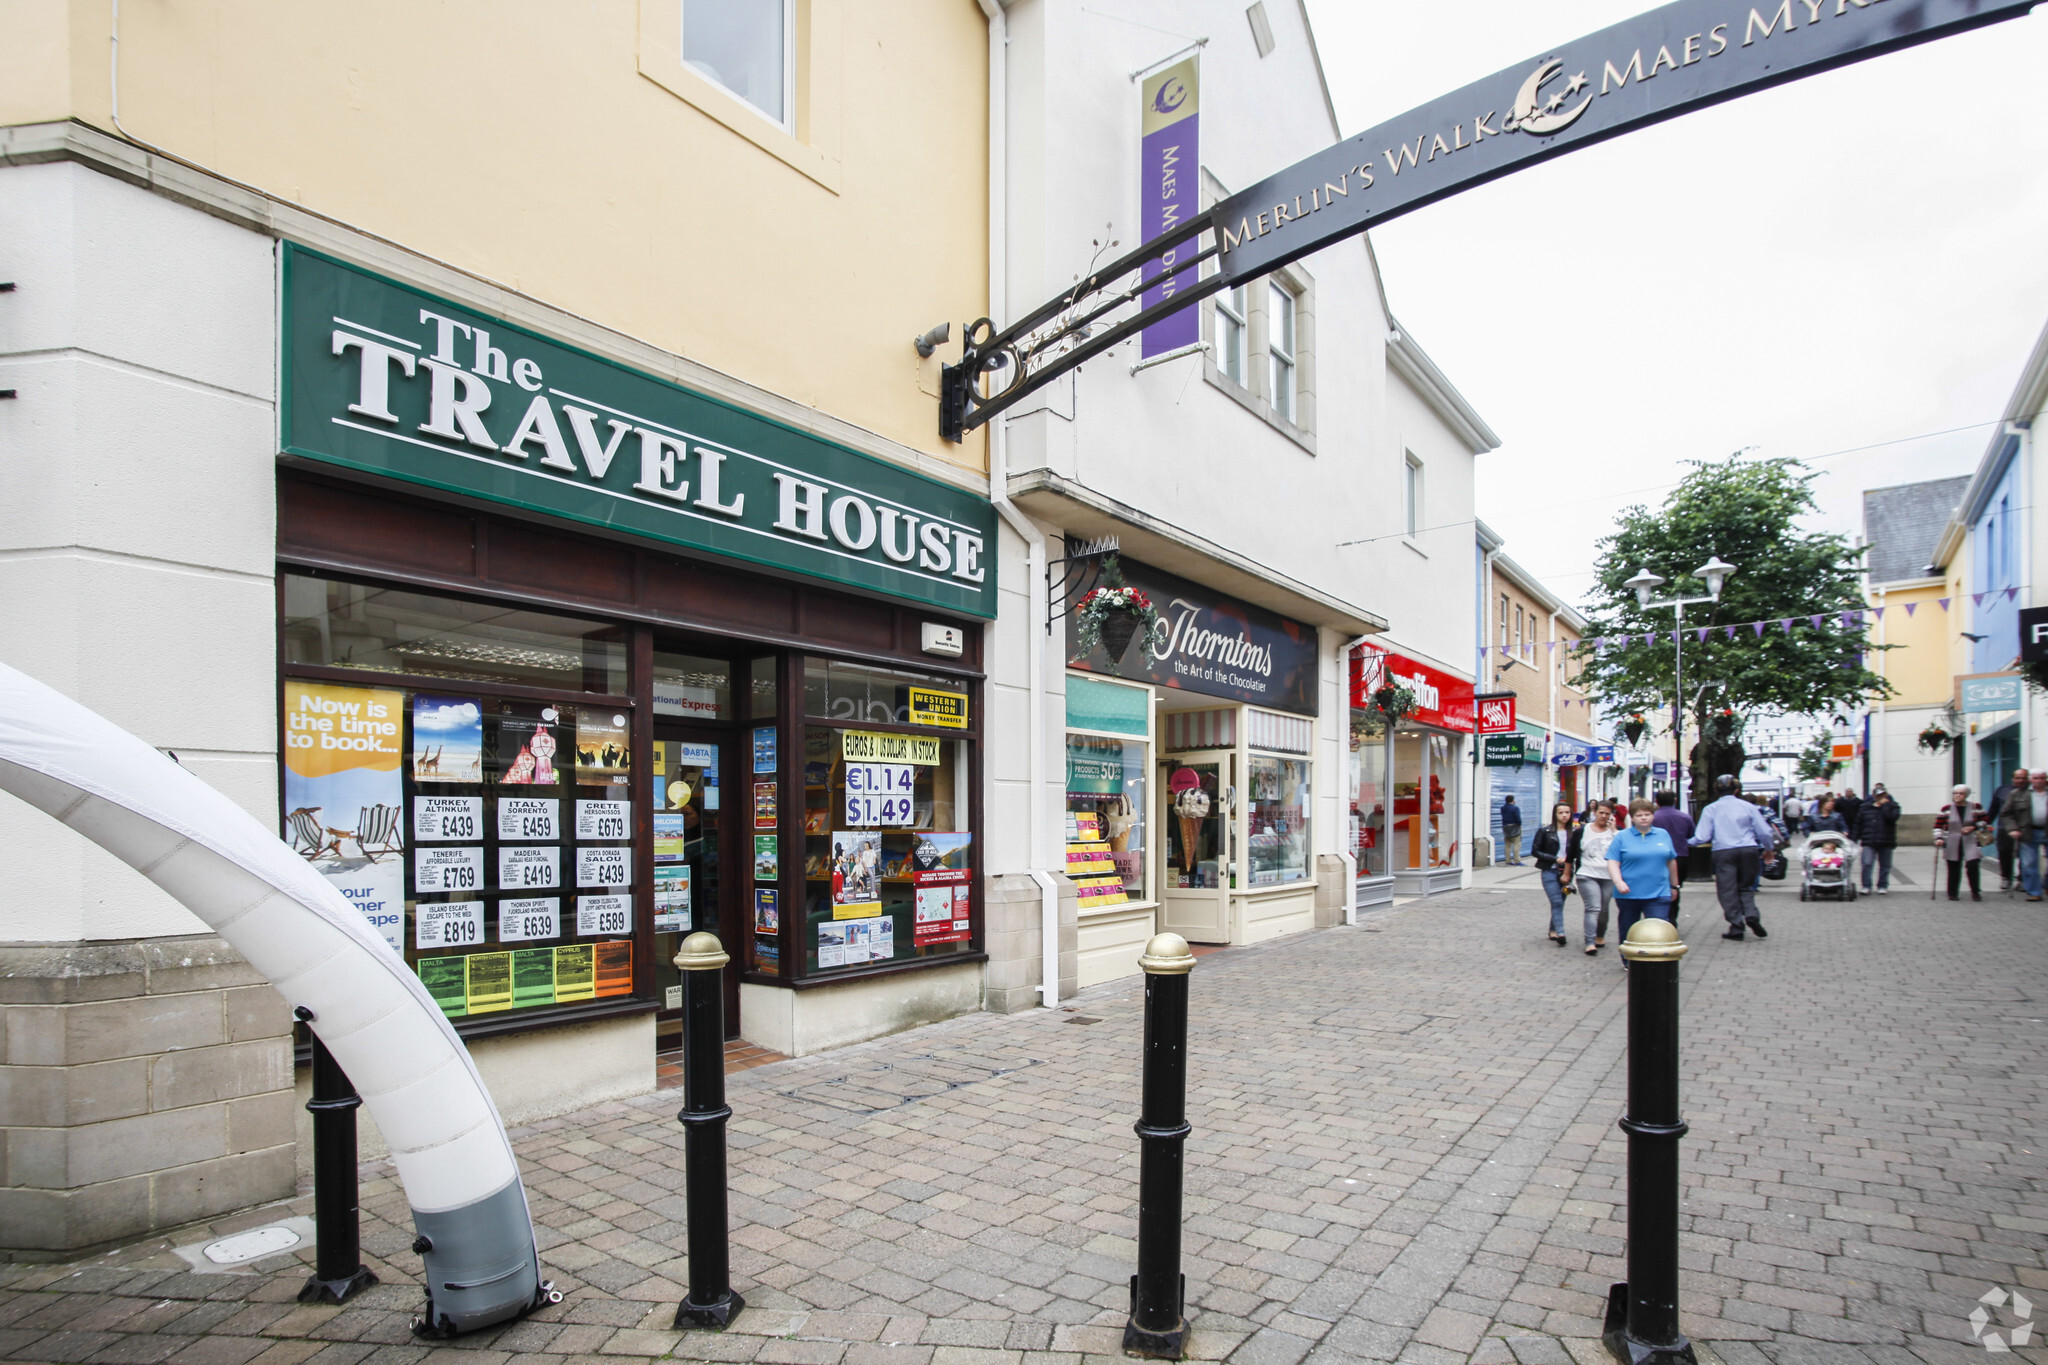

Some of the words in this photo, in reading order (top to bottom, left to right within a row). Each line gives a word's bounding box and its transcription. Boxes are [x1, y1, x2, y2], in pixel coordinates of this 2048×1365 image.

[1223, 161, 1375, 254] MERLIN'S
[1382, 110, 1501, 175] WALK
[1599, 23, 1728, 97] MAES
[1162, 145, 1180, 200] MAES
[420, 309, 543, 392] The
[332, 330, 744, 518] TRAVEL
[773, 473, 986, 583] HOUSE
[1151, 598, 1273, 677] Thorntons
[1174, 659, 1188, 676] the
[1190, 664, 1203, 680] Art
[1204, 667, 1214, 681] of
[1215, 669, 1228, 684] the
[1229, 672, 1267, 693] Chocolatier
[300, 694, 361, 716] Now
[367, 700, 388, 718] is
[914, 693, 956, 707] WESTERN
[929, 704, 956, 714] UNION
[289, 712, 334, 731] the
[341, 716, 397, 736] time
[916, 713, 935, 721] MONEY
[286, 730, 314, 749] to
[321, 733, 399, 753] book...
[845, 734, 867, 757] EUROS
[869, 736, 874, 757] &
[880, 737, 886, 757] US
[887, 737, 907, 759] DOLLARS
[911, 739, 917, 760] IN
[918, 740, 937, 761] STOCK
[690, 748, 709, 757] ABTA
[846, 767, 912, 792] €1.14
[1074, 766, 1100, 774] PRODUCTS
[848, 796, 910, 824] $1.49
[442, 816, 473, 837] £439
[523, 816, 551, 837] £459
[598, 818, 623, 837] £679
[443, 866, 475, 888] £769
[524, 865, 552, 885] £419
[598, 864, 624, 884] £439
[339, 887, 374, 899] our
[353, 901, 386, 911] mer
[367, 914, 399, 927] ape
[444, 920, 475, 942] £819
[524, 915, 552, 936] £639
[599, 912, 624, 931] £589
